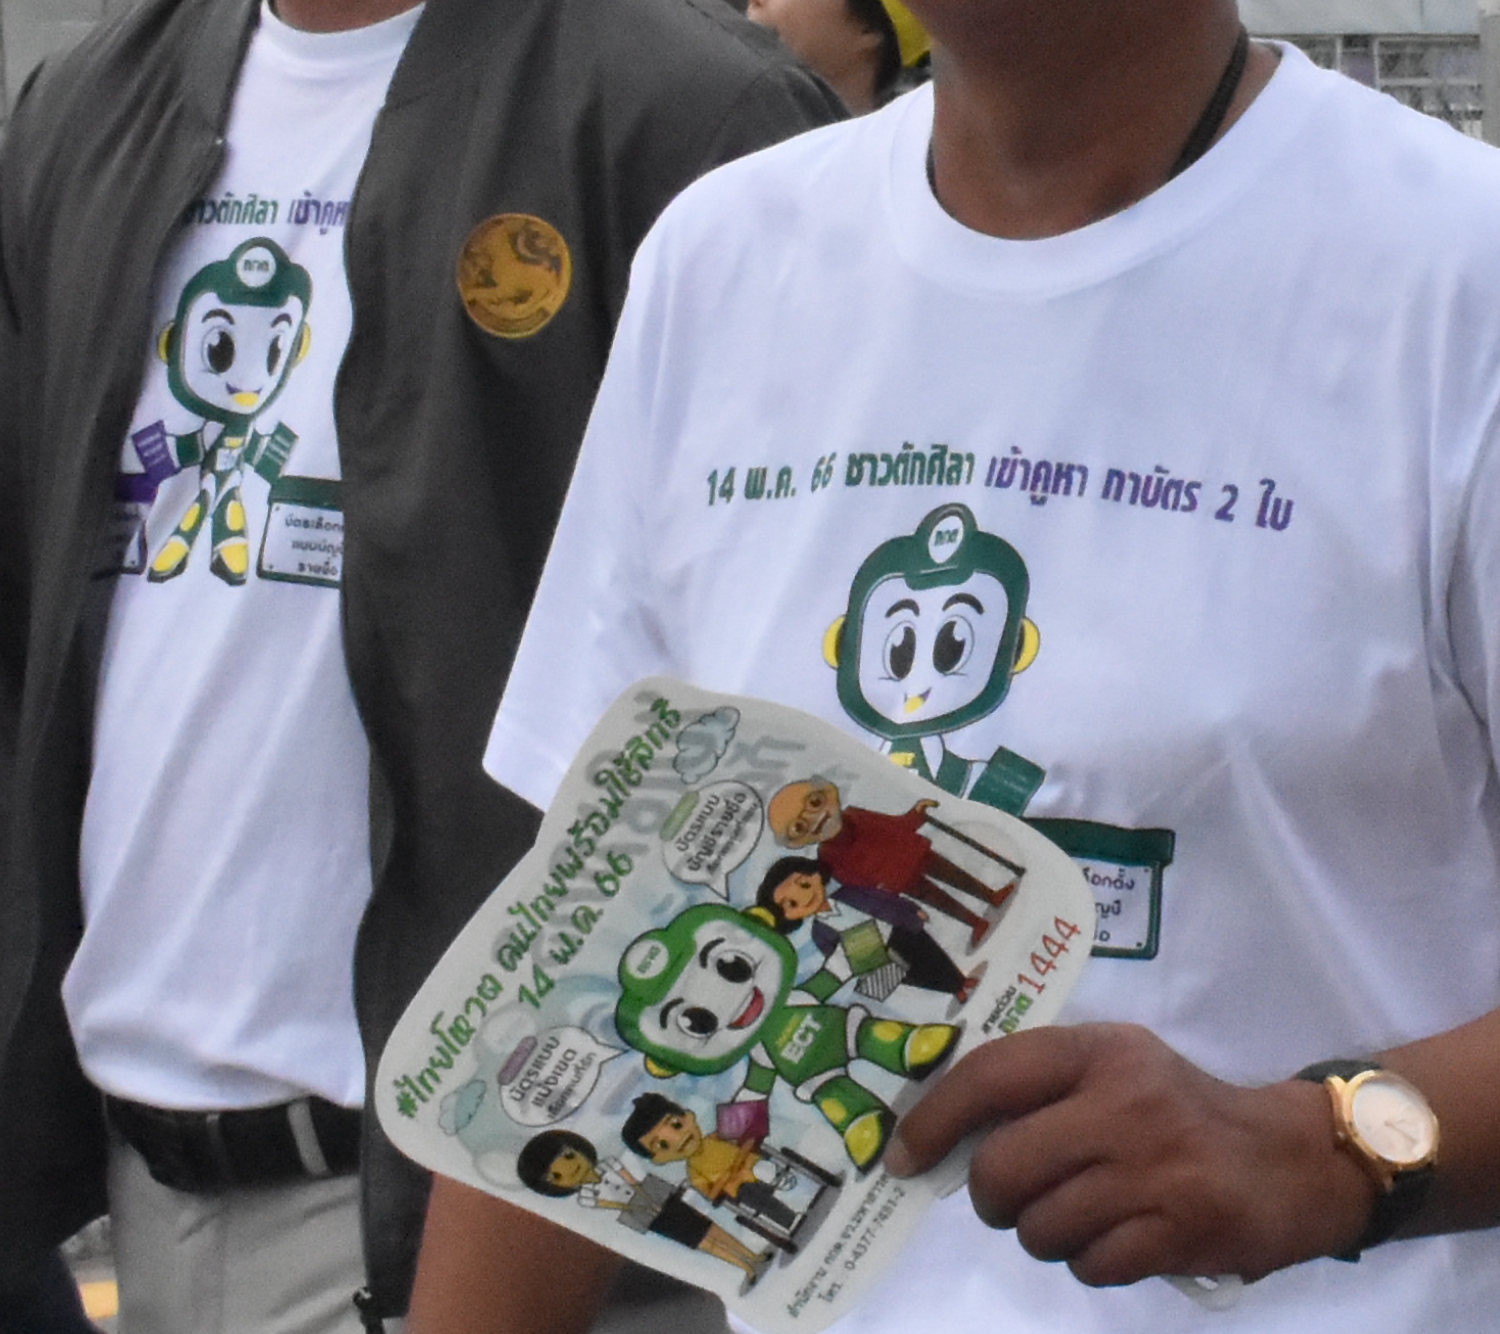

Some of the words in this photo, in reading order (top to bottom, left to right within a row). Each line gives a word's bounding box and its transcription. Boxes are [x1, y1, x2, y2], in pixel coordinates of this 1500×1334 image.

[197, 192, 279, 225] าวตักศิลา
[287, 190, 349, 235] เข้าคูห
[707, 466, 736, 506] 14
[744, 465, 797, 500] พ.ค.
[811, 451, 838, 494] 66
[844, 441, 976, 487] ชาวตักศิลา
[984, 445, 1089, 506] เข้าคูหา
[1101, 465, 1202, 513] กาบัตร
[1214, 484, 1239, 522] 2
[1255, 478, 1294, 532] ใบ
[518, 963, 557, 1010] 14
[550, 905, 605, 966] พ.ค.
[594, 849, 634, 897] 66
[1017, 915, 1082, 995] 1444
[780, 1013, 823, 1064] ECT
